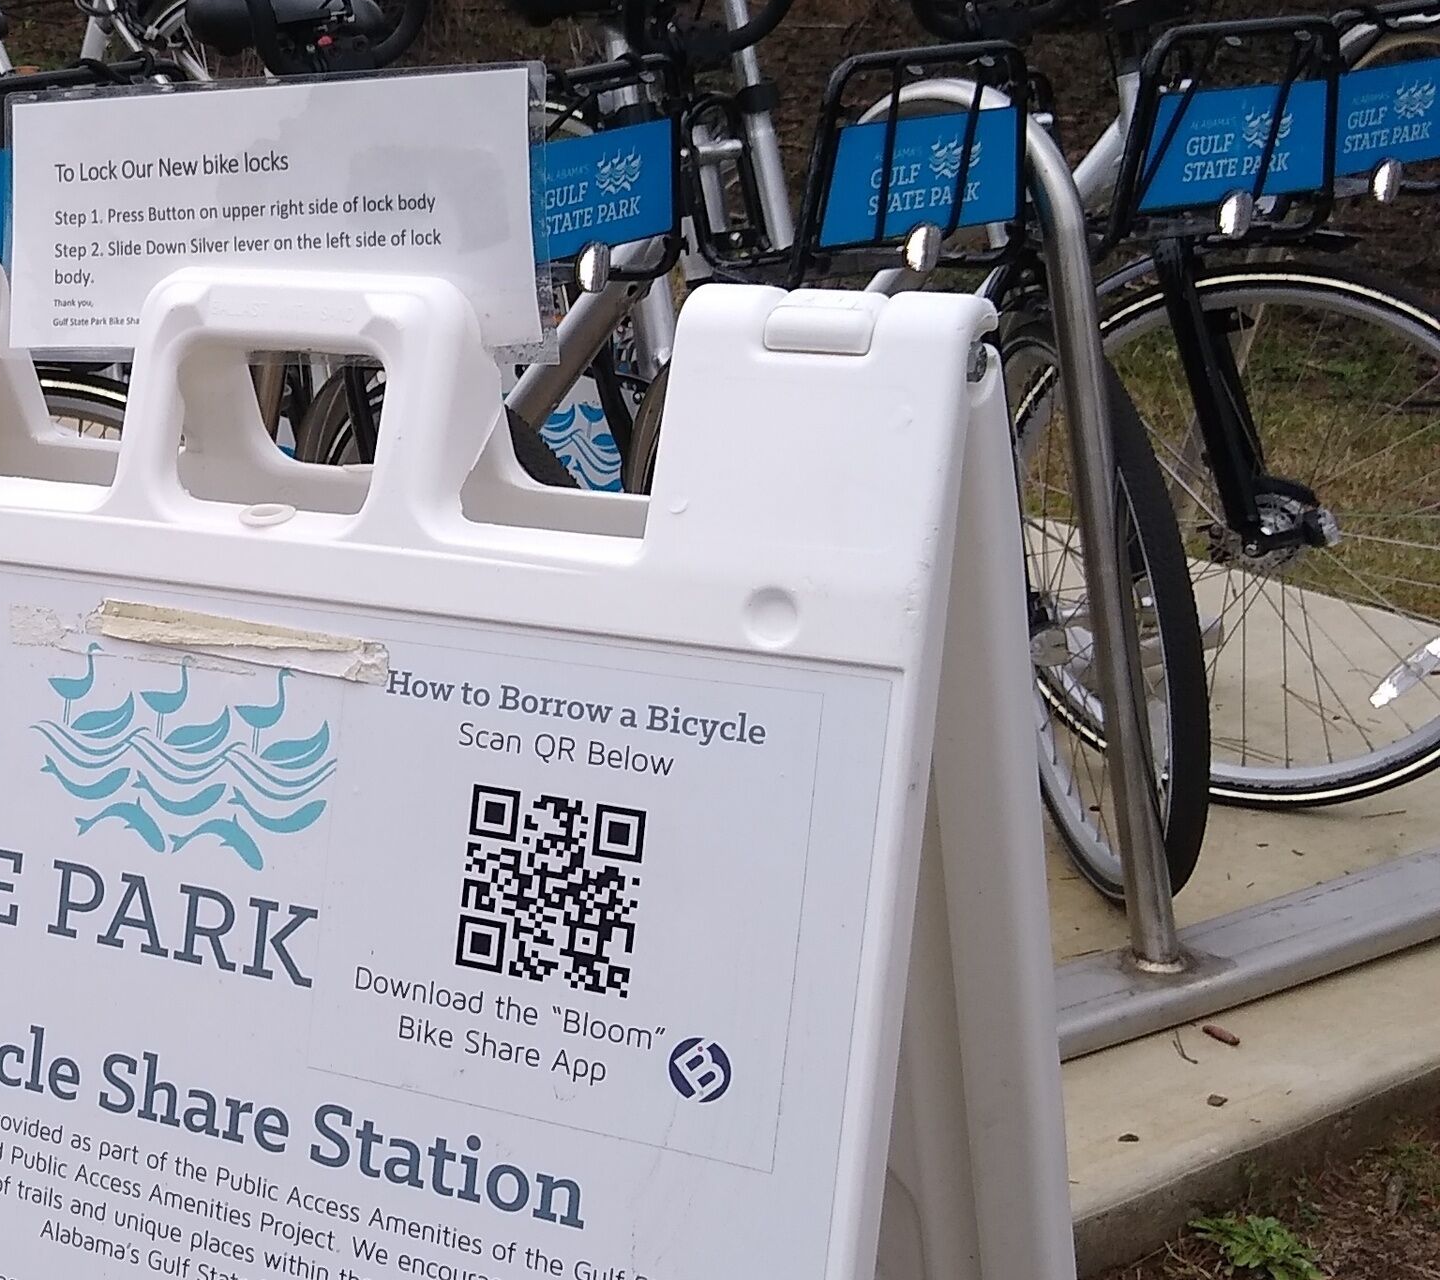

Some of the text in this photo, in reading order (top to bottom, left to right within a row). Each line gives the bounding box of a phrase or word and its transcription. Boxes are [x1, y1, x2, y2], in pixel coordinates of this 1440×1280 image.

[1347, 107, 1388, 130] GULF
[1186, 134, 1235, 156] GULF
[1343, 121, 1432, 154] STATE PARK
[53, 149, 289, 184] To Lock Our New bike locks
[1183, 157, 1238, 183] STATE
[54, 192, 436, 229] Step 1. Press Button on upper right side of lock body
[543, 181, 588, 210] GULF
[868, 181, 981, 215] SATE PAK
[541, 196, 641, 237] STATE PARK
[54, 227, 443, 262] Step 2. Slide Down Silver lever on the left side of lock
[54, 267, 95, 288] body.
[53, 297, 95, 309] Thank you,
[52, 316, 69, 327] Gulf
[69, 317, 90, 328] State
[90, 316, 108, 326] Park
[108, 316, 125, 326] Bike
[385, 669, 767, 747] How to Borrow a Bicycle
[458, 721, 675, 777] Scan QR Below
[47, 859, 320, 989] PARK
[354, 965, 484, 1015] Download
[494, 995, 539, 1027] the
[398, 1014, 607, 1087] Bike Share App
[98, 1050, 290, 1154] Share
[309, 1103, 585, 1231] Station
[70, 1133, 92, 1153] as
[98, 1140, 140, 1166] part
[146, 1151, 169, 1173] of
[174, 1156, 208, 1183] the
[215, 1166, 280, 1202] Public
[285, 1185, 361, 1223] Access
[367, 1207, 483, 1256] Amenities
[491, 1241, 518, 1264] of
[524, 1247, 564, 1277] the
